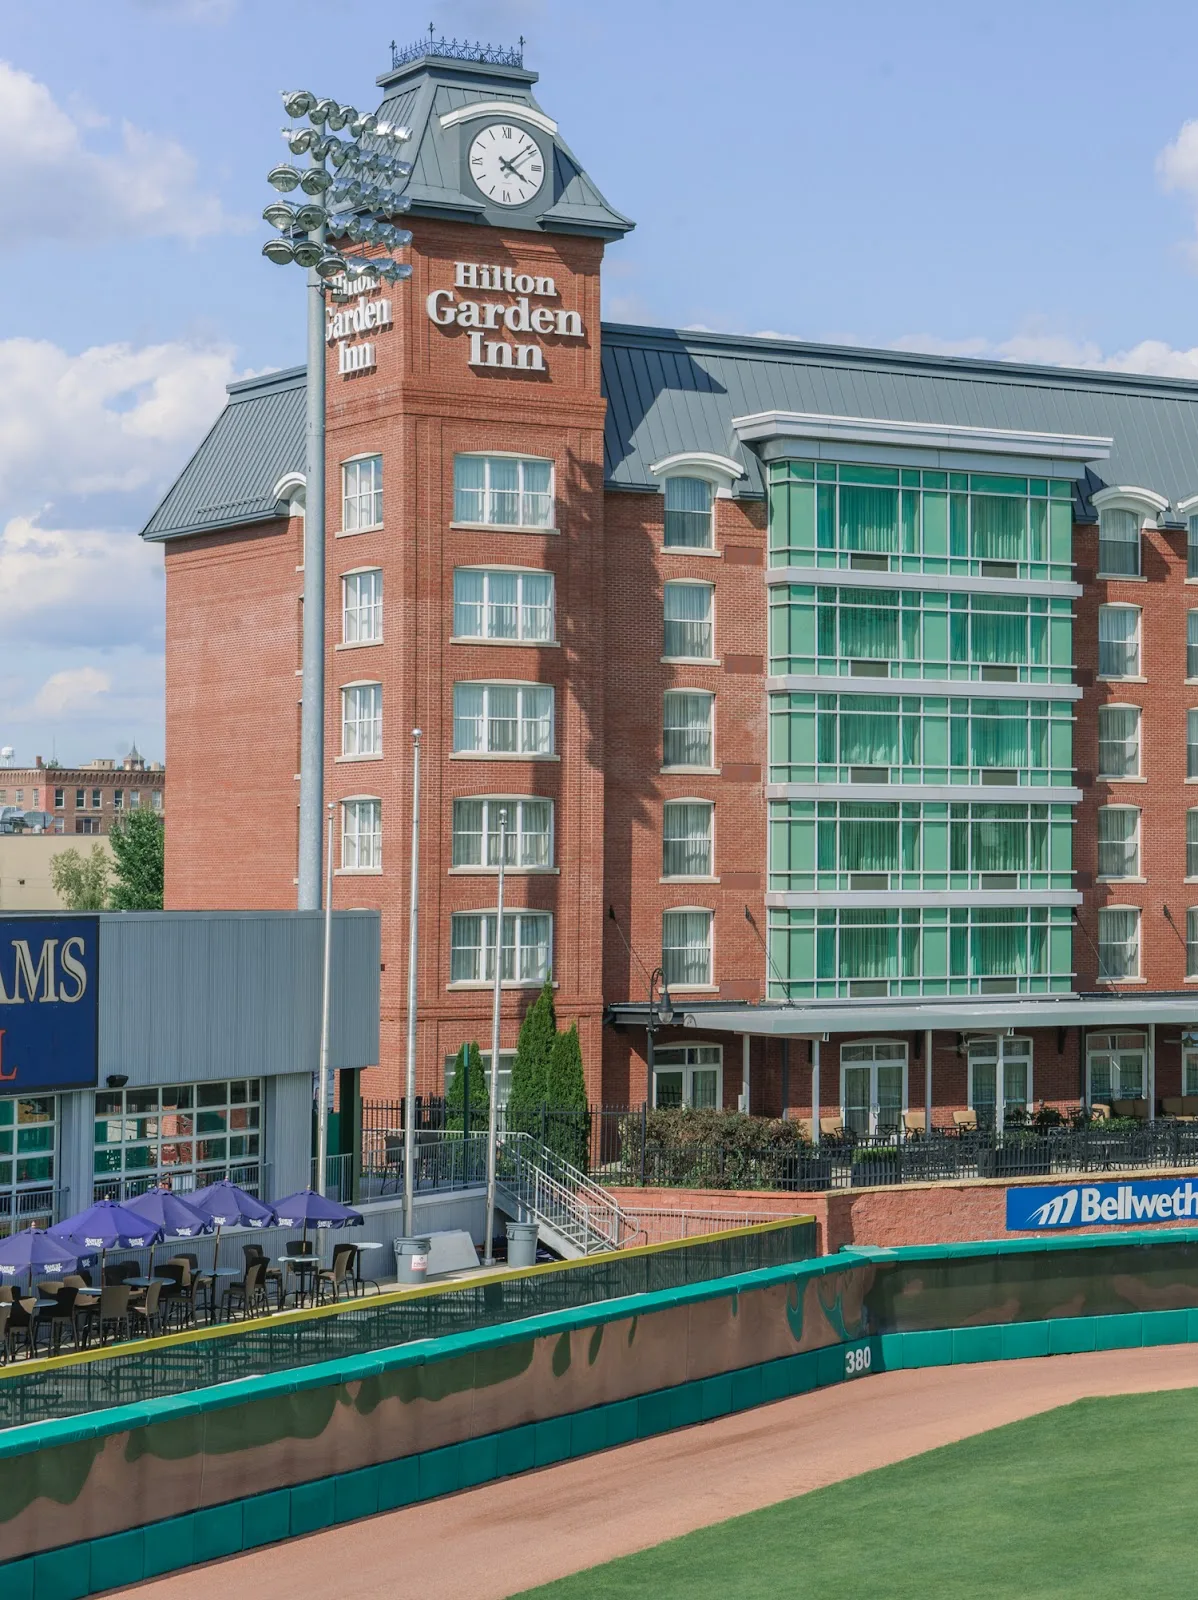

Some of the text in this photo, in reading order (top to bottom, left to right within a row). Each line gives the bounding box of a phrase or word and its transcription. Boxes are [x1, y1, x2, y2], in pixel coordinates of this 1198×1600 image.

[454, 261, 557, 297] Hilton
[426, 289, 585, 337] Garden
[338, 340, 376, 374] Inn
[467, 331, 546, 371] Inn
[845, 1346, 871, 1374] 380
